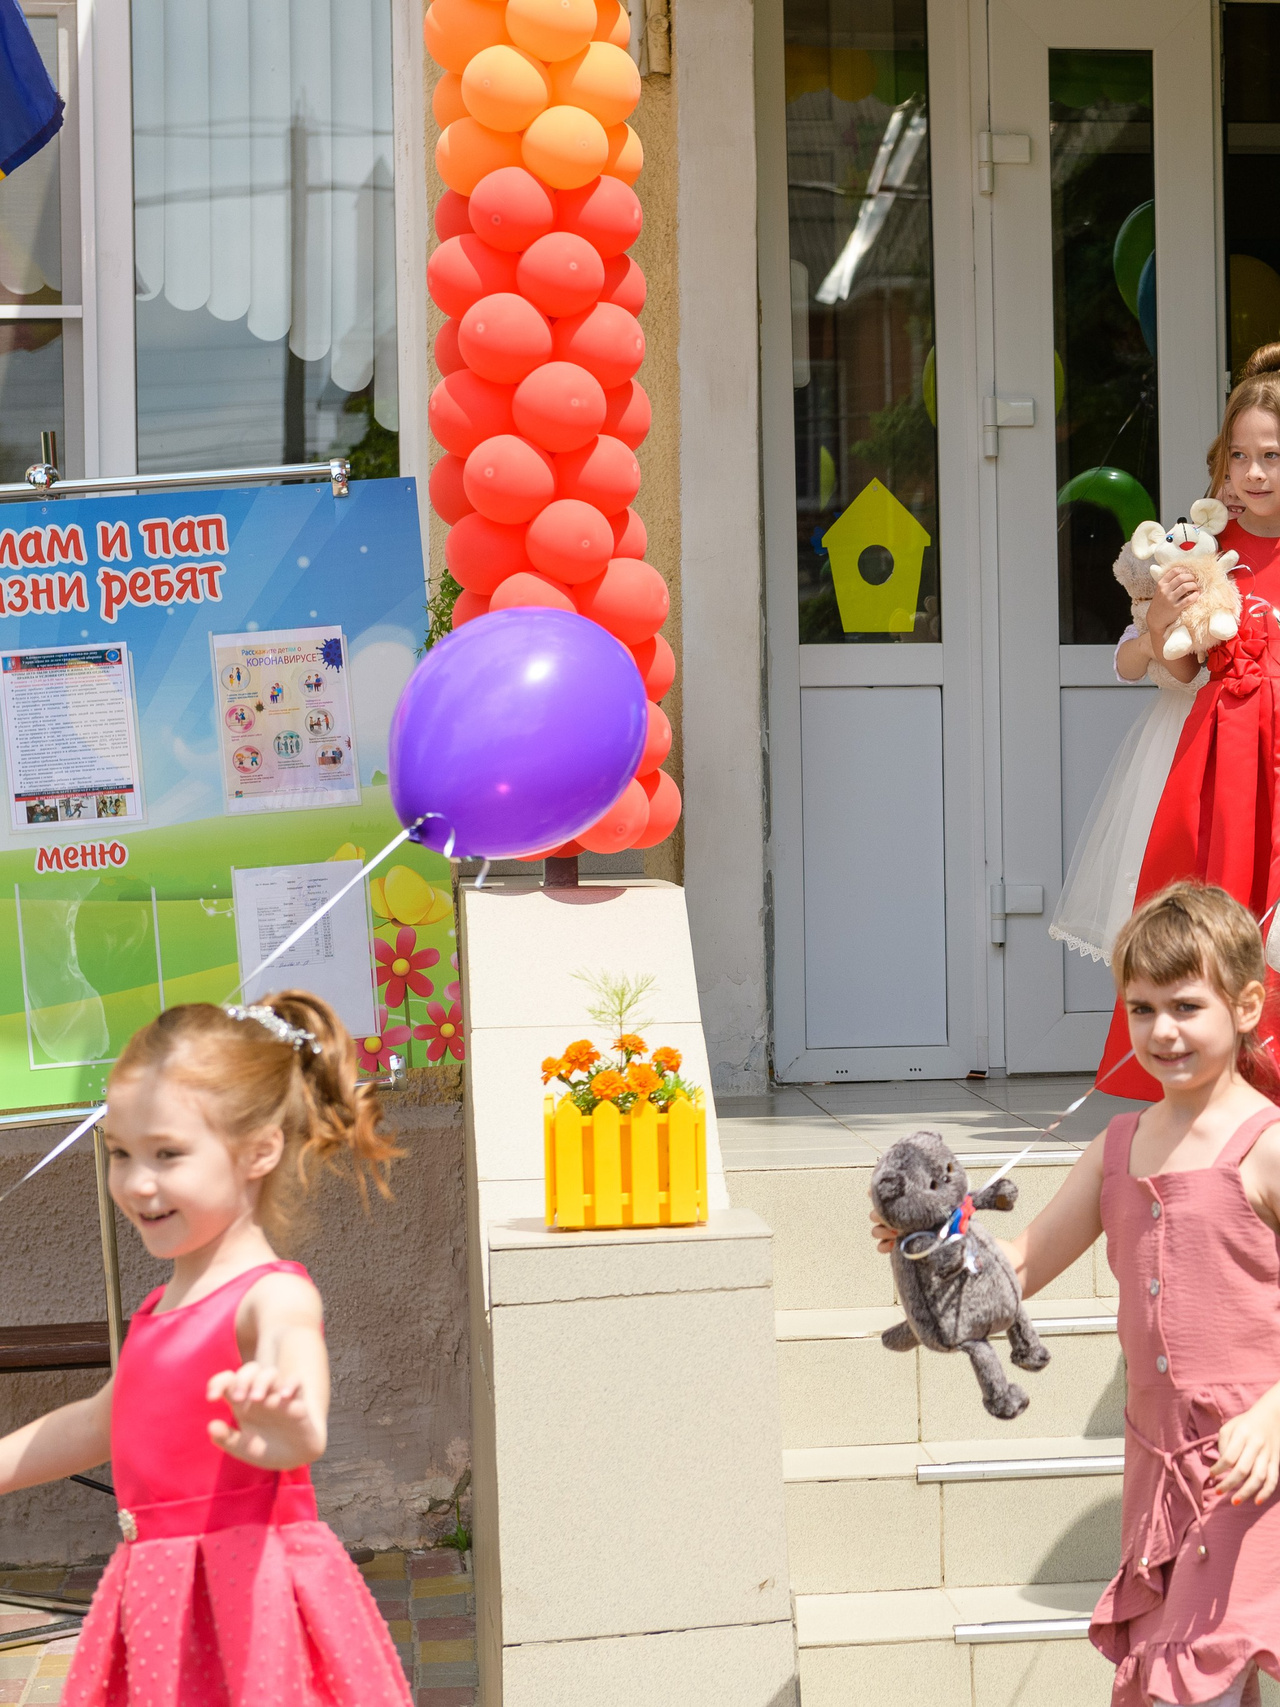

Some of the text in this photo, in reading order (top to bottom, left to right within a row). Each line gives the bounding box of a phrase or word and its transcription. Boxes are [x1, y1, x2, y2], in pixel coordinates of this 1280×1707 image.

[100, 525, 129, 558] и
[142, 518, 226, 555] пап
[0, 565, 222, 620] зни ребят
[246, 653, 317, 668] КОРОНАВИРУСЕ
